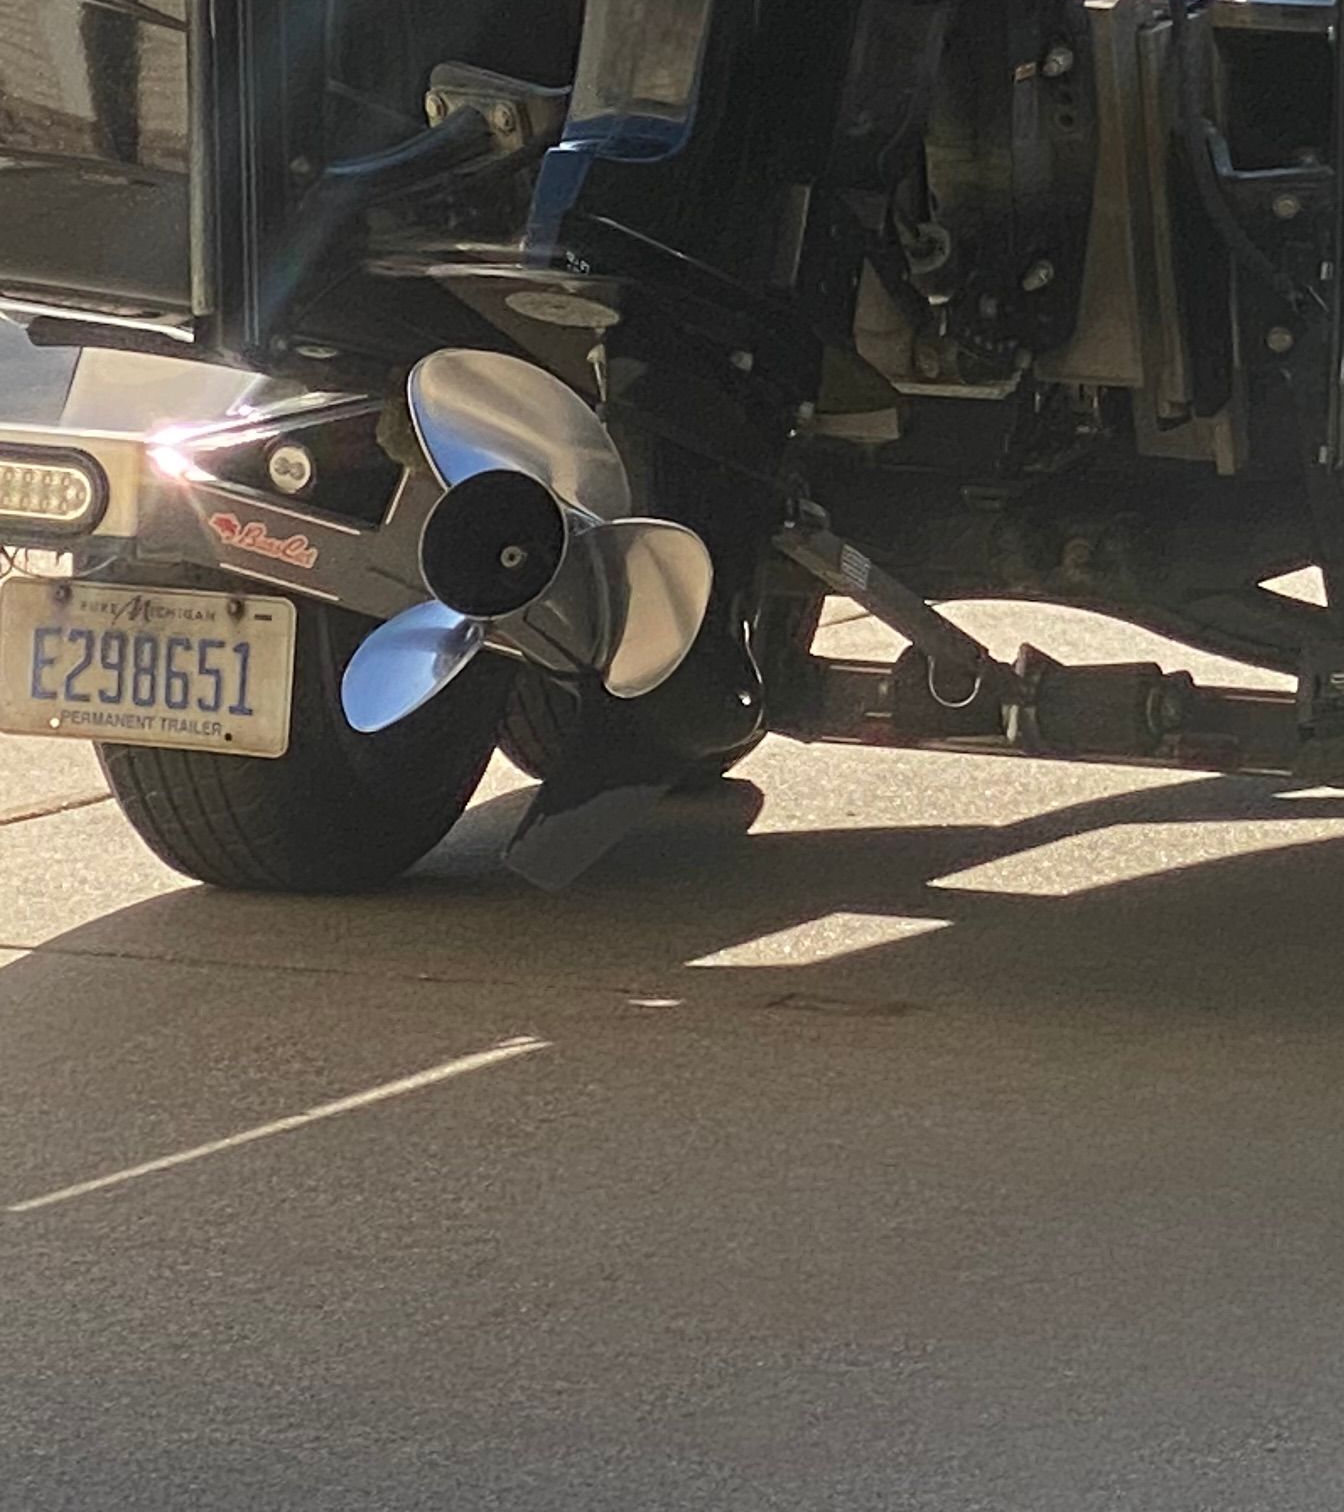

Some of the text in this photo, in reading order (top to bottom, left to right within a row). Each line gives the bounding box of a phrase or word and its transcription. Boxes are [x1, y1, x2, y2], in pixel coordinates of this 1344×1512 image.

[30, 625, 254, 717] E298651
[59, 708, 223, 737] PERMANENT TRAILER
